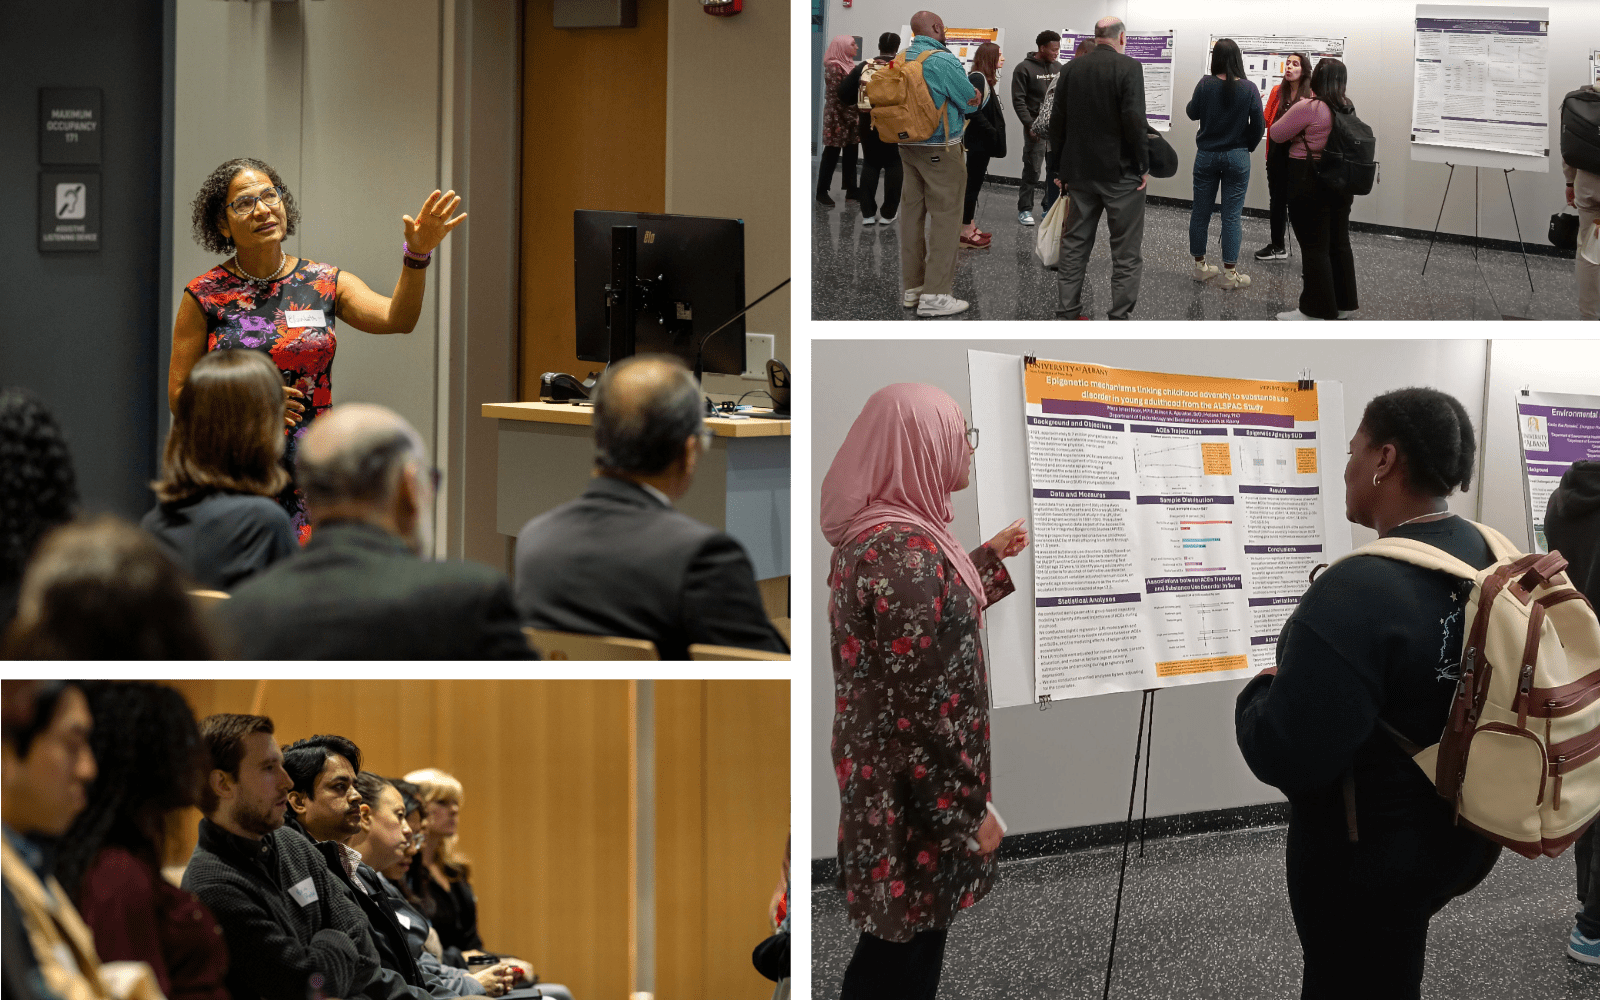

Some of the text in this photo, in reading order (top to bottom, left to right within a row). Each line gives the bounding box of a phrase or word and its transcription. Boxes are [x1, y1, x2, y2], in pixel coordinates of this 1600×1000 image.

[51, 109, 92, 119] MAXIMUM
[46, 121, 97, 131] OCCUPANCY
[65, 133, 79, 143] 171
[1082, 366, 1108, 376] ALBANY
[1046, 376, 1089, 387] Epigenetic
[1090, 381, 1136, 392] mechanisms
[1137, 384, 1162, 396] linking
[1163, 387, 1198, 398] childhood
[1200, 391, 1231, 401] adversity
[1232, 392, 1240, 400] to
[1241, 393, 1275, 402] substance
[1081, 390, 1263, 412] disorder in young adulthood from the ALSPAC Study
[1551, 408, 1599, 419] Environmental
[1033, 418, 1070, 427] Background
[1083, 421, 1112, 430] Objectives
[1171, 427, 1202, 435] Trajectories
[1146, 578, 1179, 586] Associations
[1057, 596, 1116, 605] Statistical Analyses
